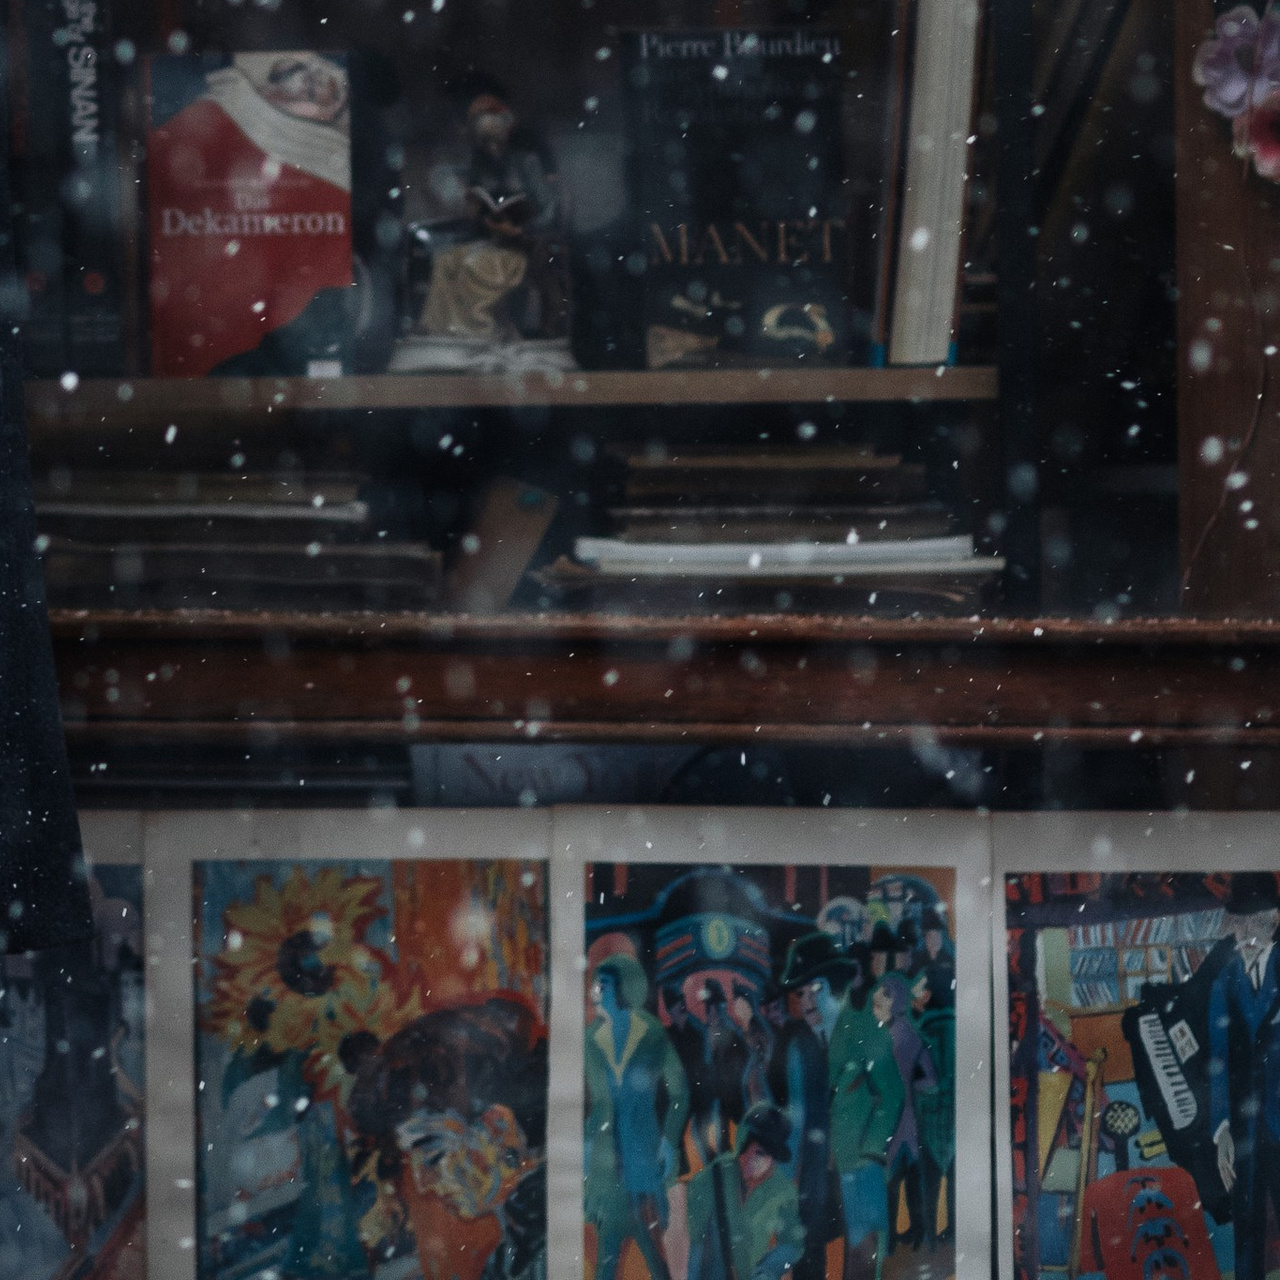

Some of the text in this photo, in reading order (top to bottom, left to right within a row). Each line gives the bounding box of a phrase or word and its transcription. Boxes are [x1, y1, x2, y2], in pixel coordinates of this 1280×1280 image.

[640, 31, 718, 58] Pierre
[161, 206, 346, 237] Dekameron
[649, 219, 846, 266] MANET
